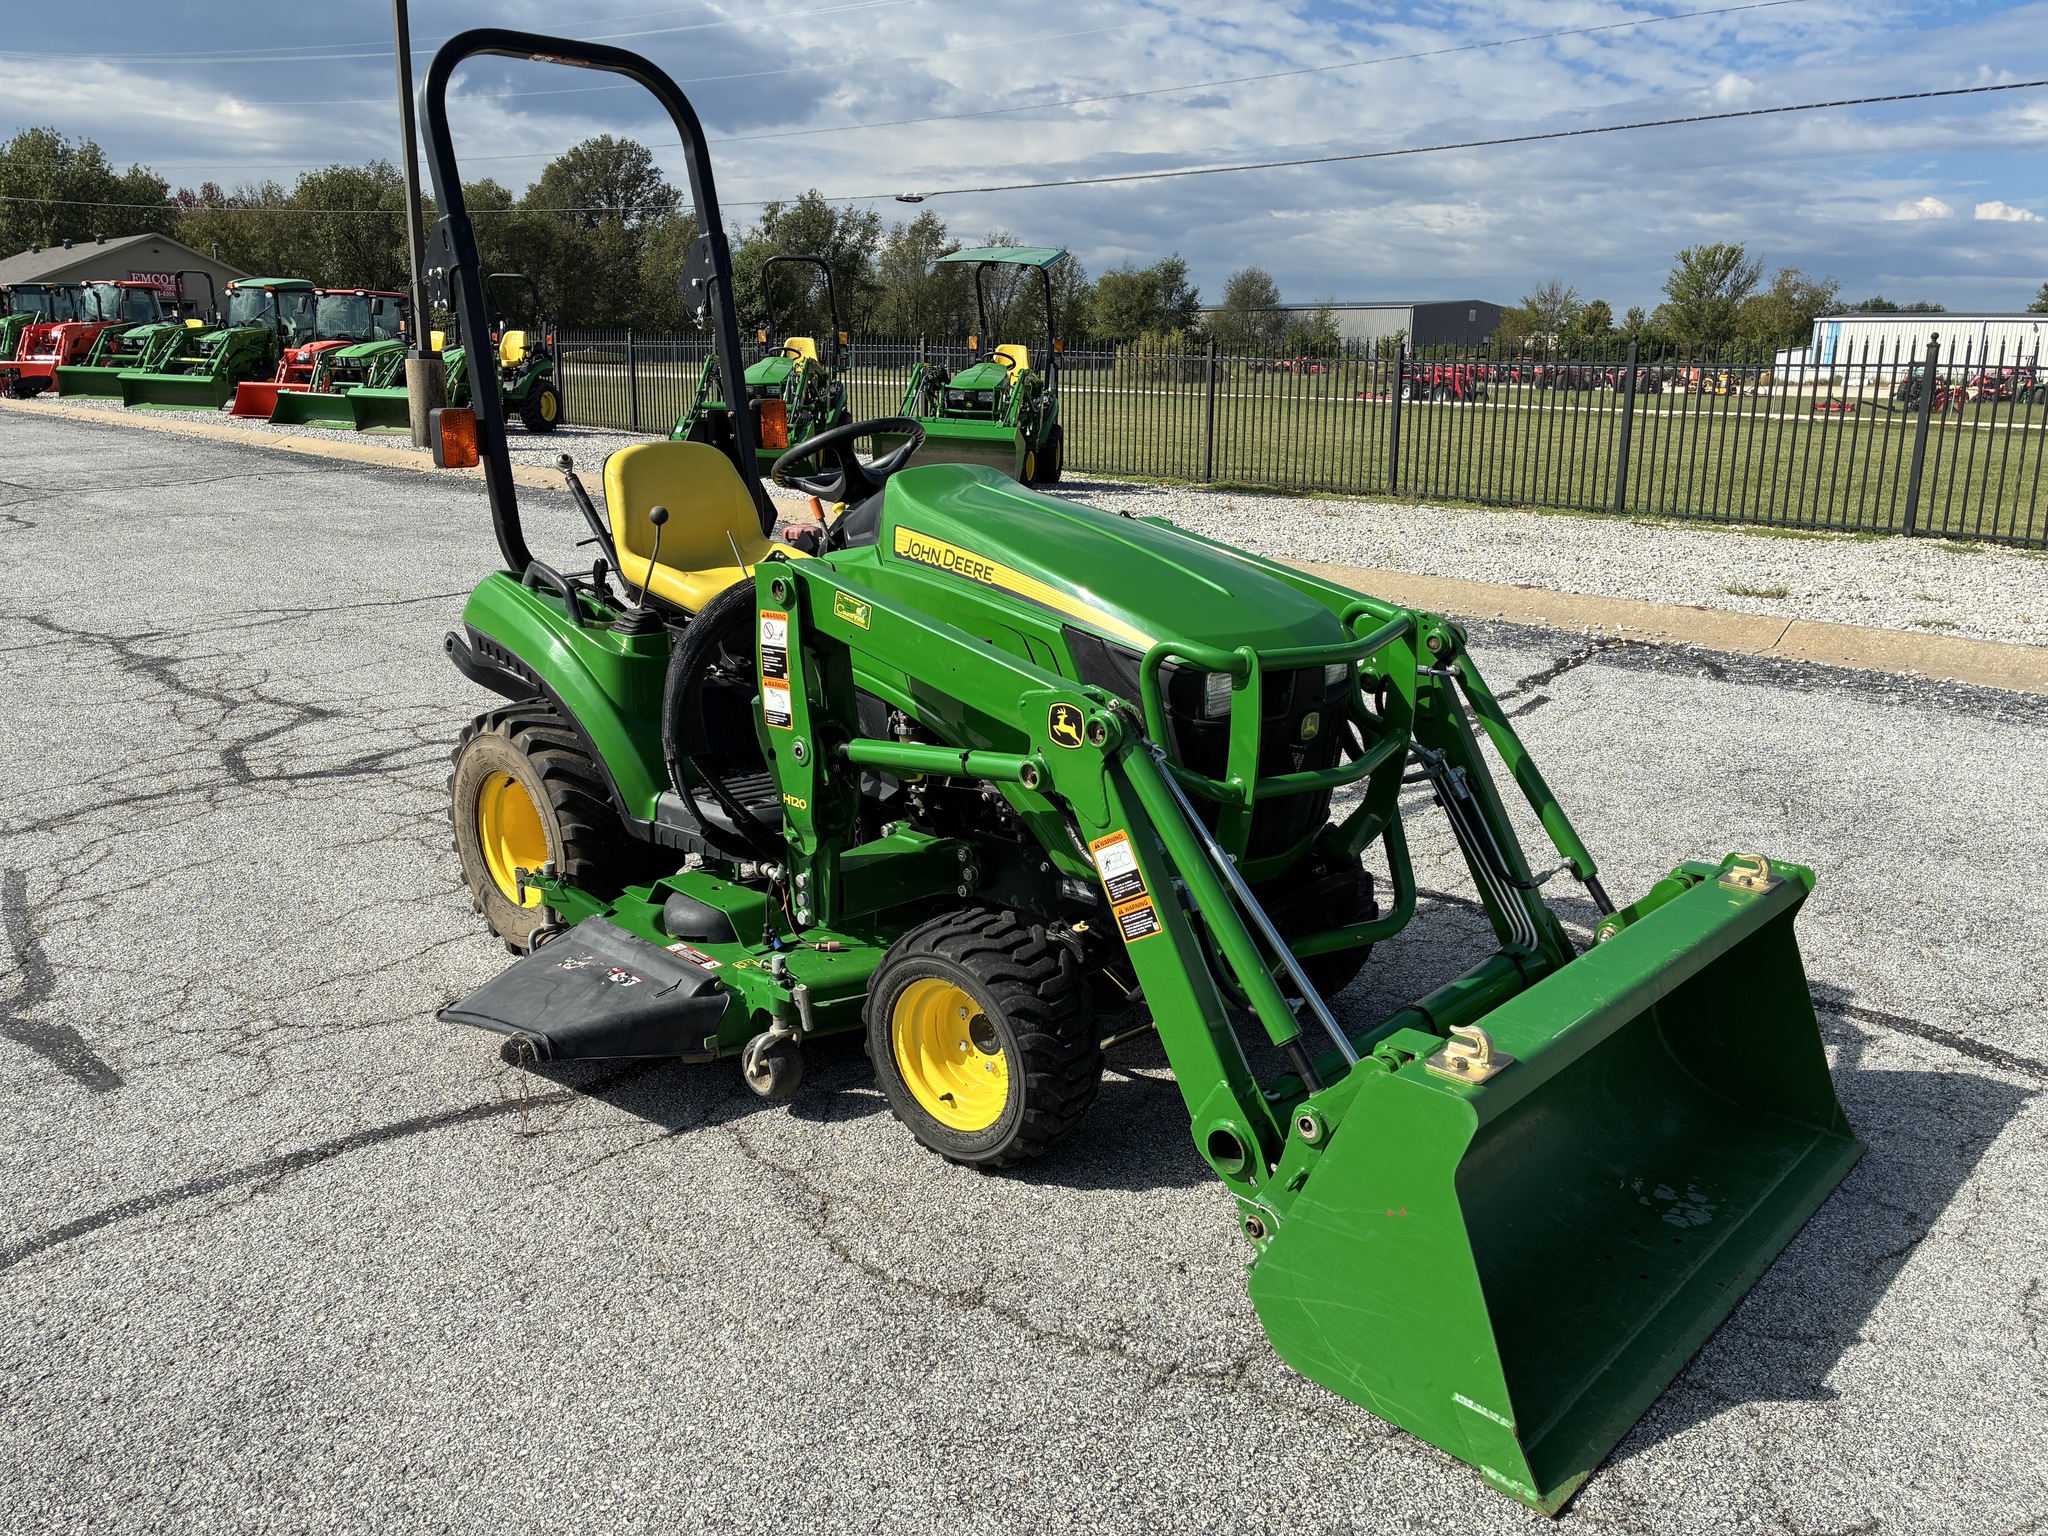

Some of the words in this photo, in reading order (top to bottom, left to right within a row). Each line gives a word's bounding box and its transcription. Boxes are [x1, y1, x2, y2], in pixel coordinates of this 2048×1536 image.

[131, 273, 169, 285] EMCO
[903, 538, 942, 564] JOHN
[943, 548, 994, 582] DEERE
[765, 612, 787, 620] WARNING
[767, 681, 789, 689] WARNING
[783, 792, 808, 810] H120
[1100, 833, 1123, 847] WARNING
[1124, 900, 1149, 913] WARNING
